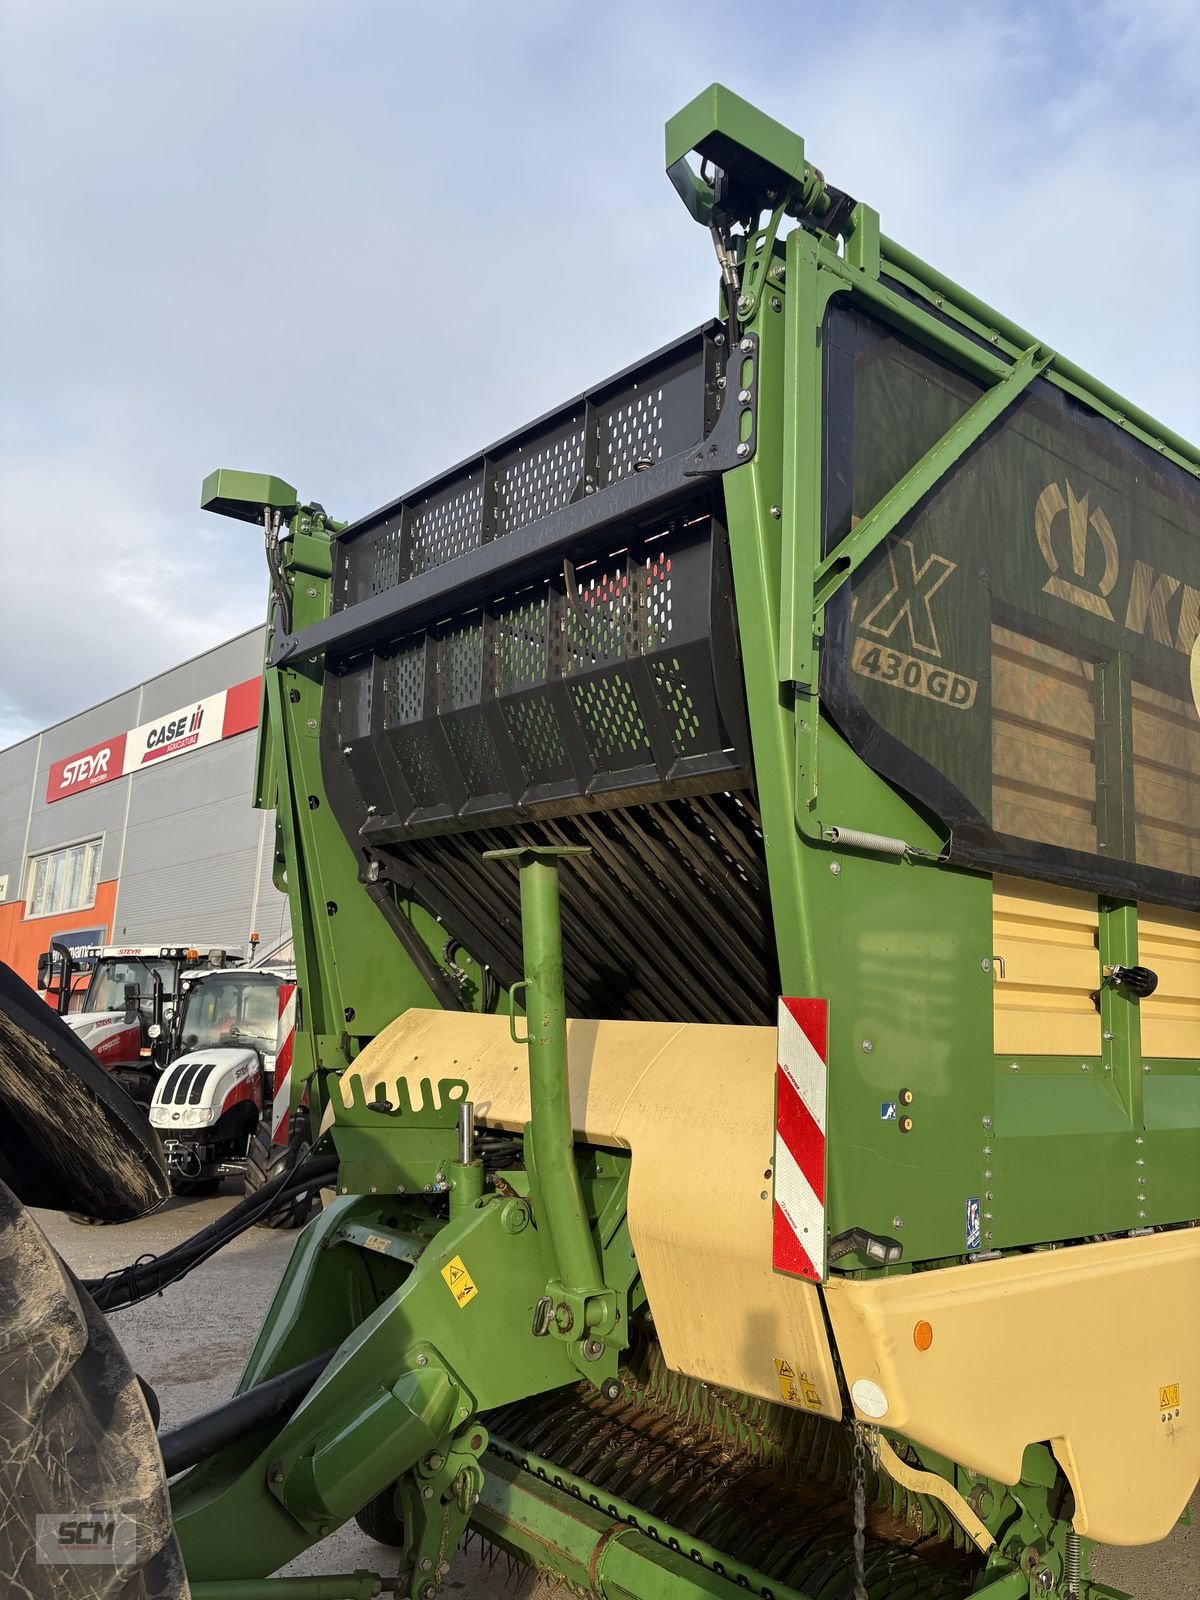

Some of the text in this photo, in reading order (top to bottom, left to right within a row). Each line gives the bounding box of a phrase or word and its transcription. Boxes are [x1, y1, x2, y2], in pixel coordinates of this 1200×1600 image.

[851, 530, 957, 657] X
[147, 716, 187, 749] CASE
[166, 734, 198, 753] AGRICULTURE
[59, 748, 111, 789] STEYR
